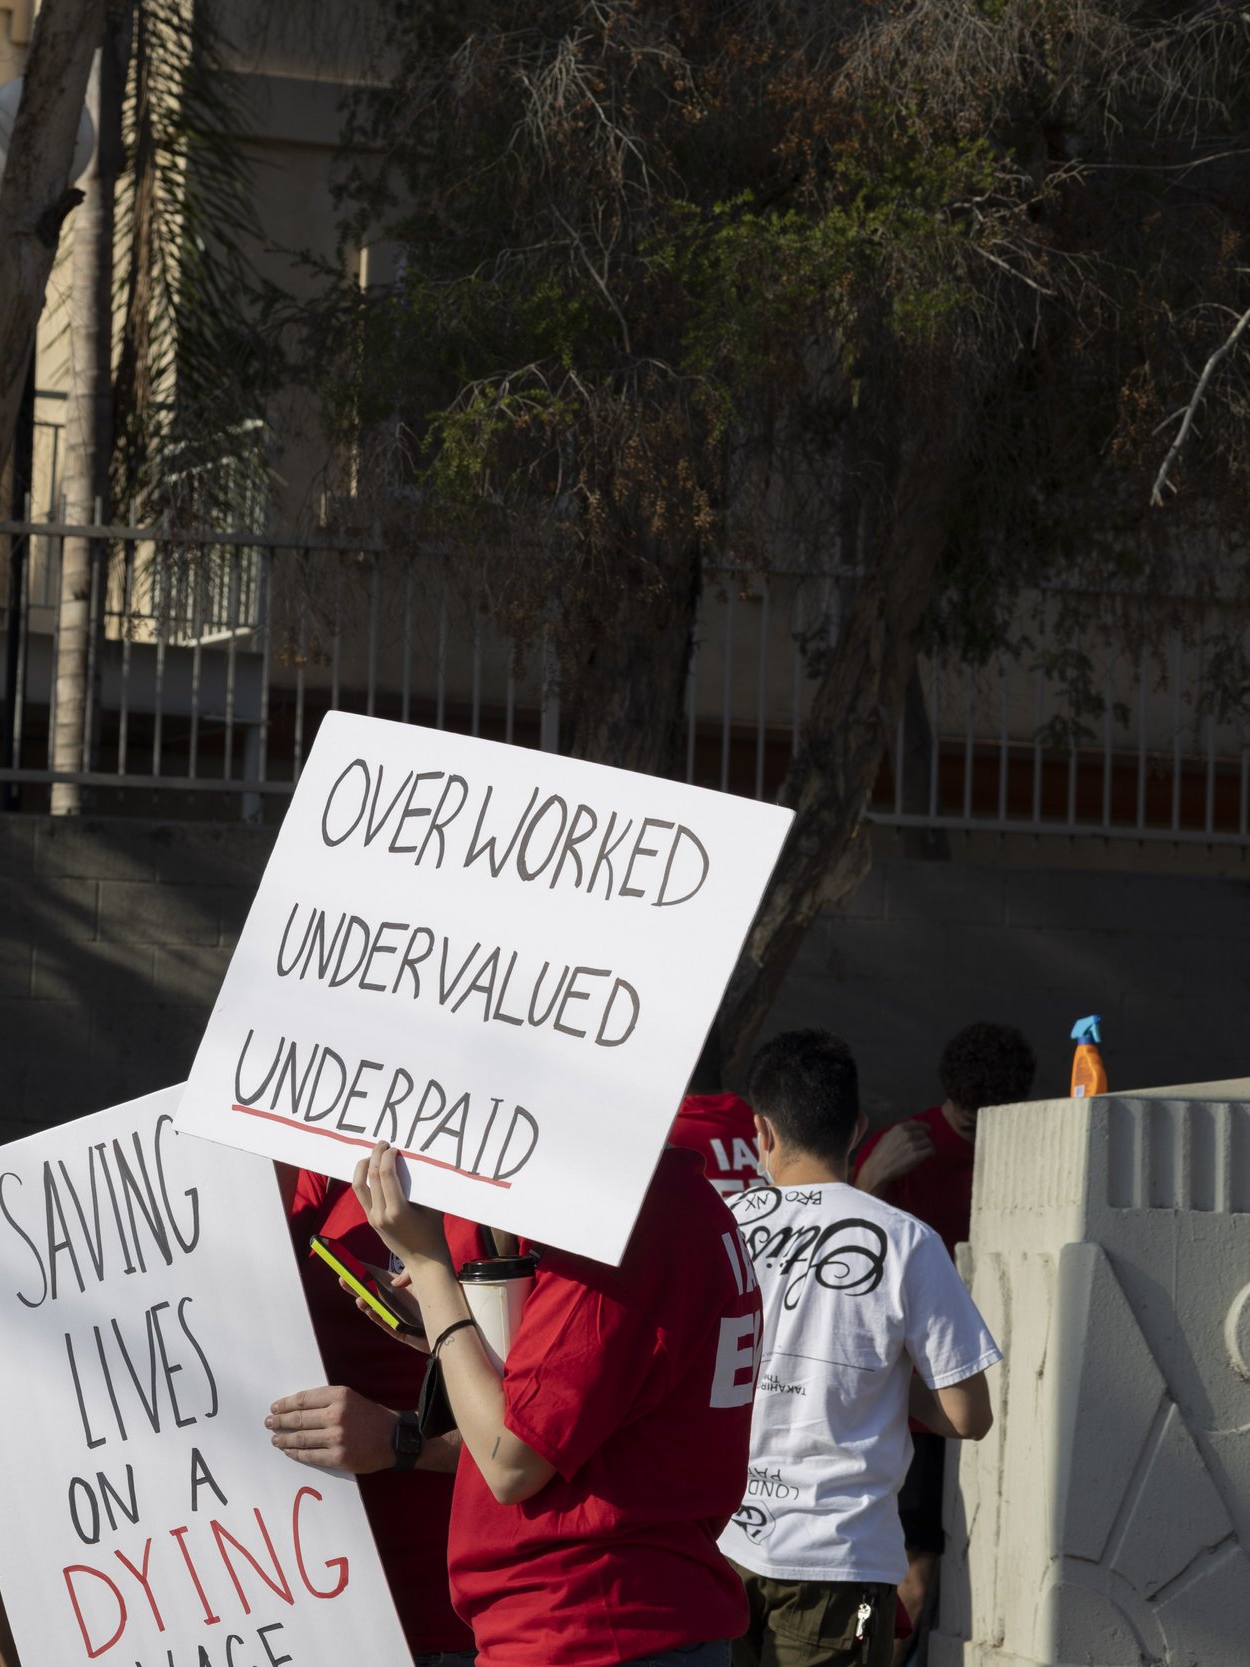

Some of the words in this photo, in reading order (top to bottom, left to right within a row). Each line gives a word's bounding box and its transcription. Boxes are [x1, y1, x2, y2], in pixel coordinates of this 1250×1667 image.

[321, 758, 710, 907] OVERWORKED
[276, 902, 641, 1047] UNDERVALUED
[234, 1029, 540, 1182] UNDERPAID
[64, 1296, 219, 1449] LIVES
[67, 1464, 140, 1546] ON
[190, 1447, 229, 1512] A
[63, 1486, 349, 1659] DYING
